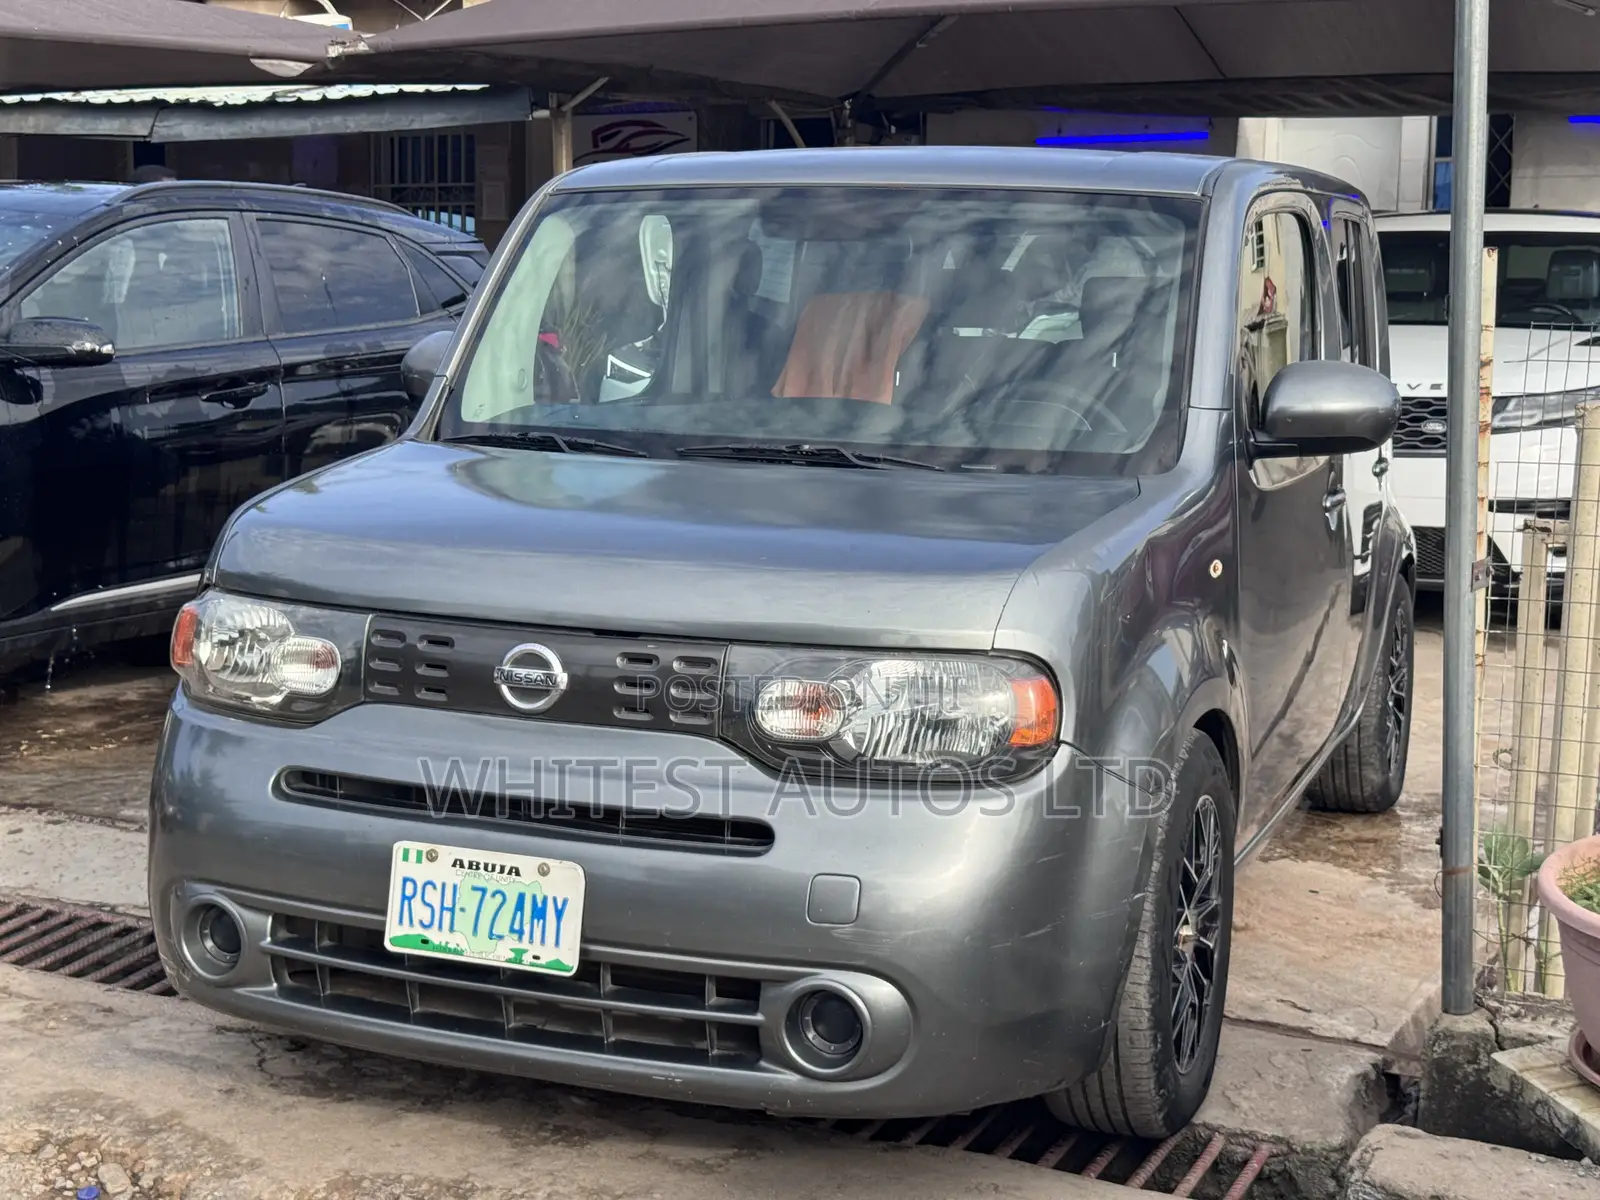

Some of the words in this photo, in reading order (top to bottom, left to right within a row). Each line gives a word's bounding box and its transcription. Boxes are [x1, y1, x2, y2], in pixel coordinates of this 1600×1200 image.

[499, 670, 557, 686] NISSAN
[451, 858, 522, 877] ABUJA
[398, 876, 569, 948] RSH-724MY
